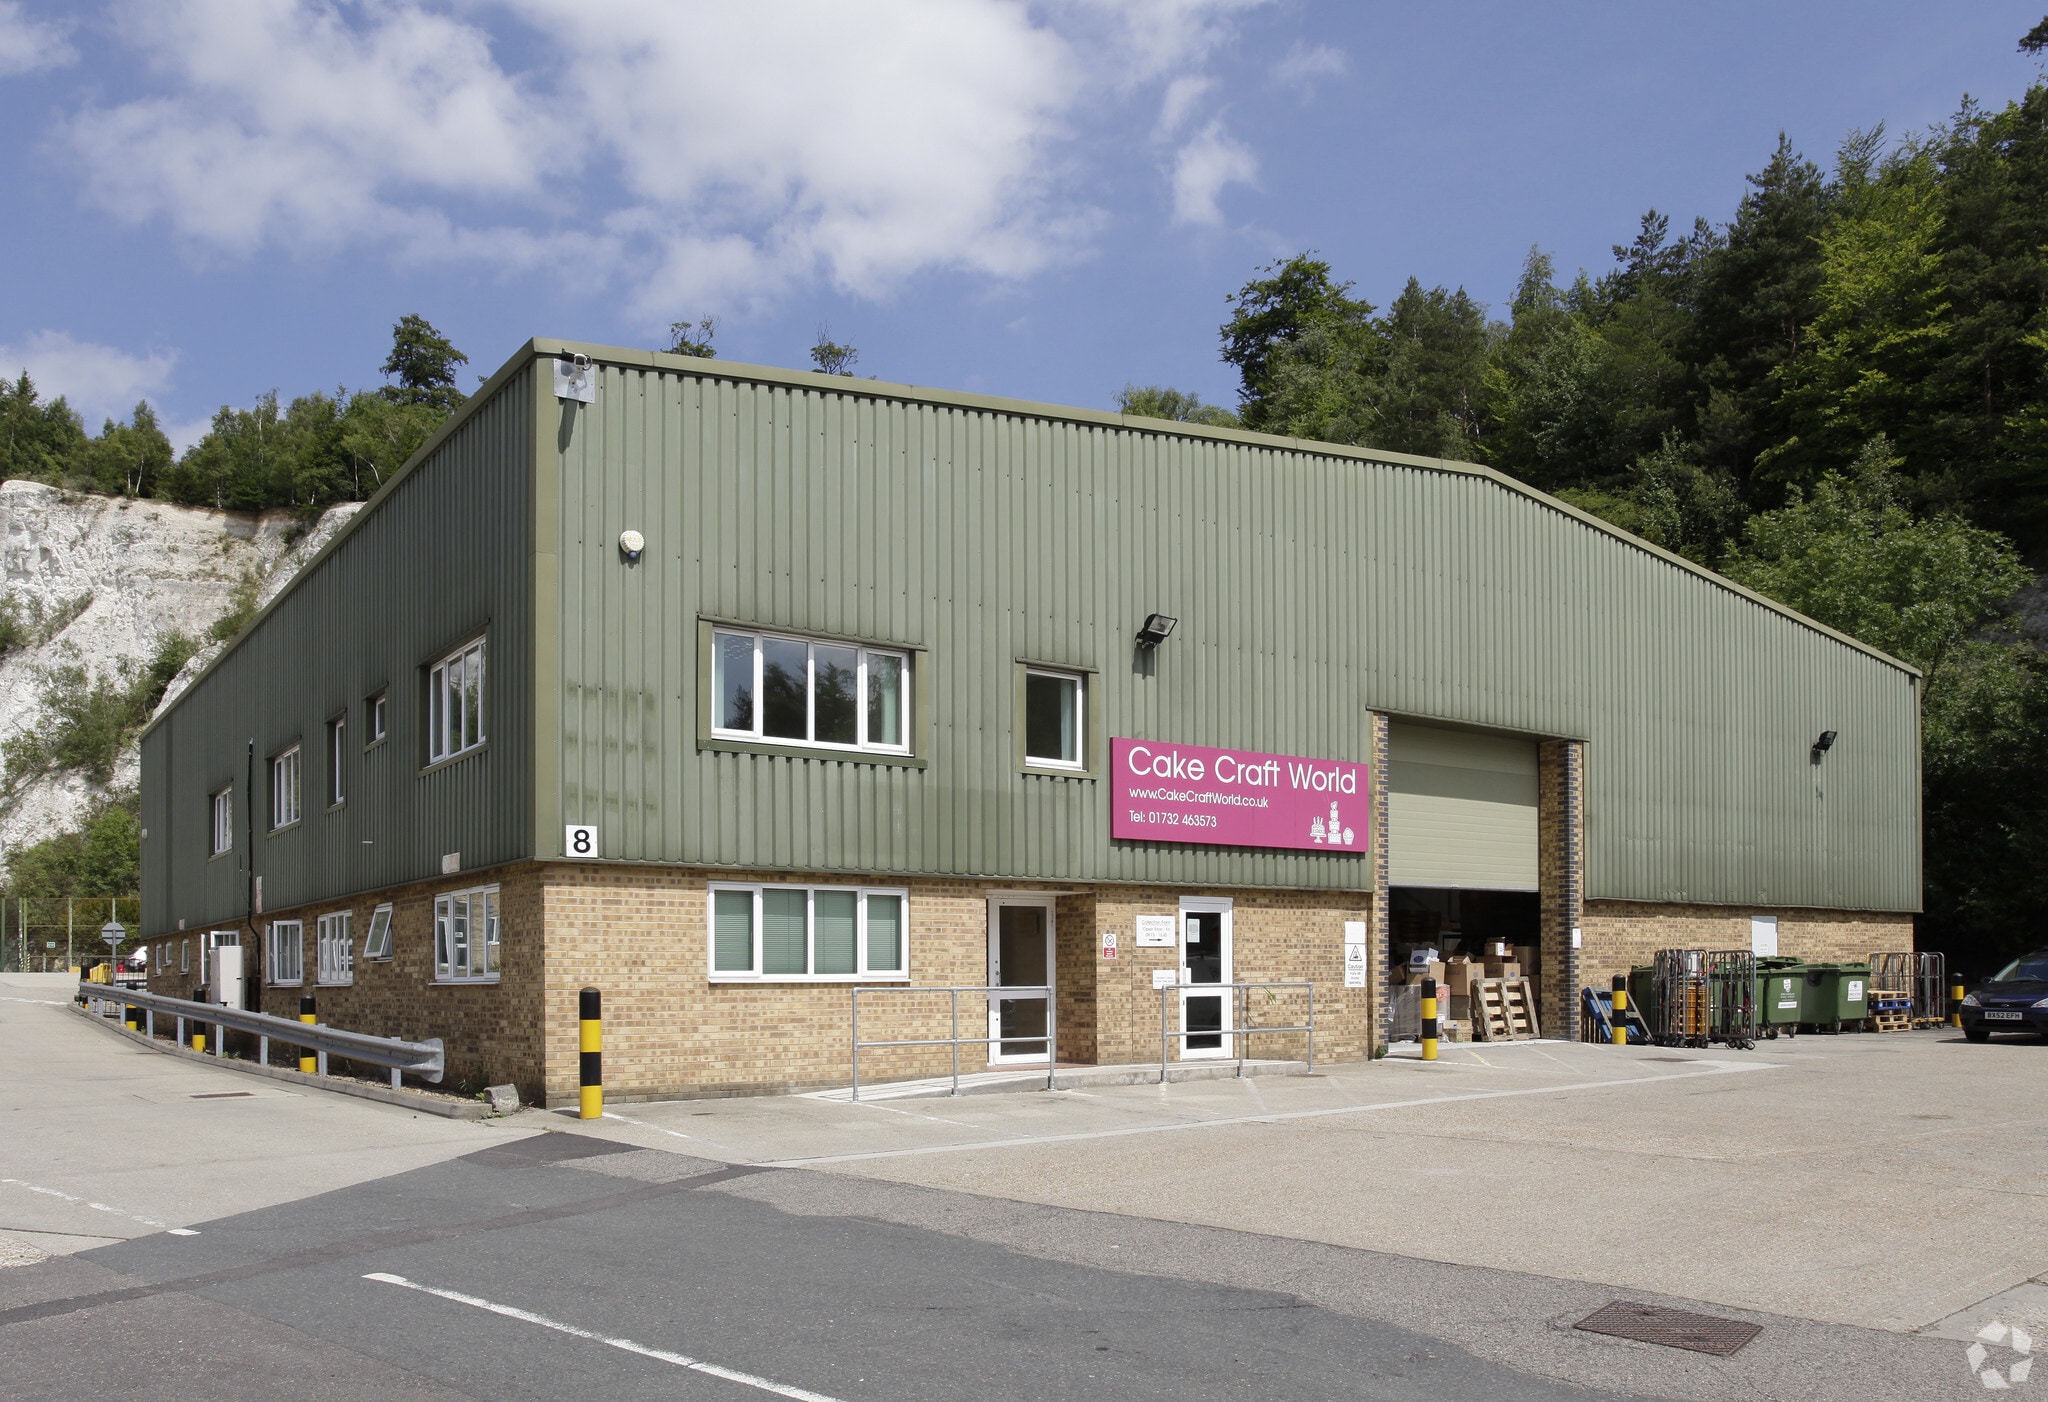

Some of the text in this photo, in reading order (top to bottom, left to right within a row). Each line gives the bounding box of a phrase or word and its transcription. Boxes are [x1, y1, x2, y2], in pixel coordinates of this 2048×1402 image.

[1128, 746, 1356, 794] Cake Craft World
[1128, 787, 1269, 808] www.CakeCraftWorld.co.uk
[1128, 810, 1217, 827] Tel: 01732 463573
[573, 829, 591, 854] 8
